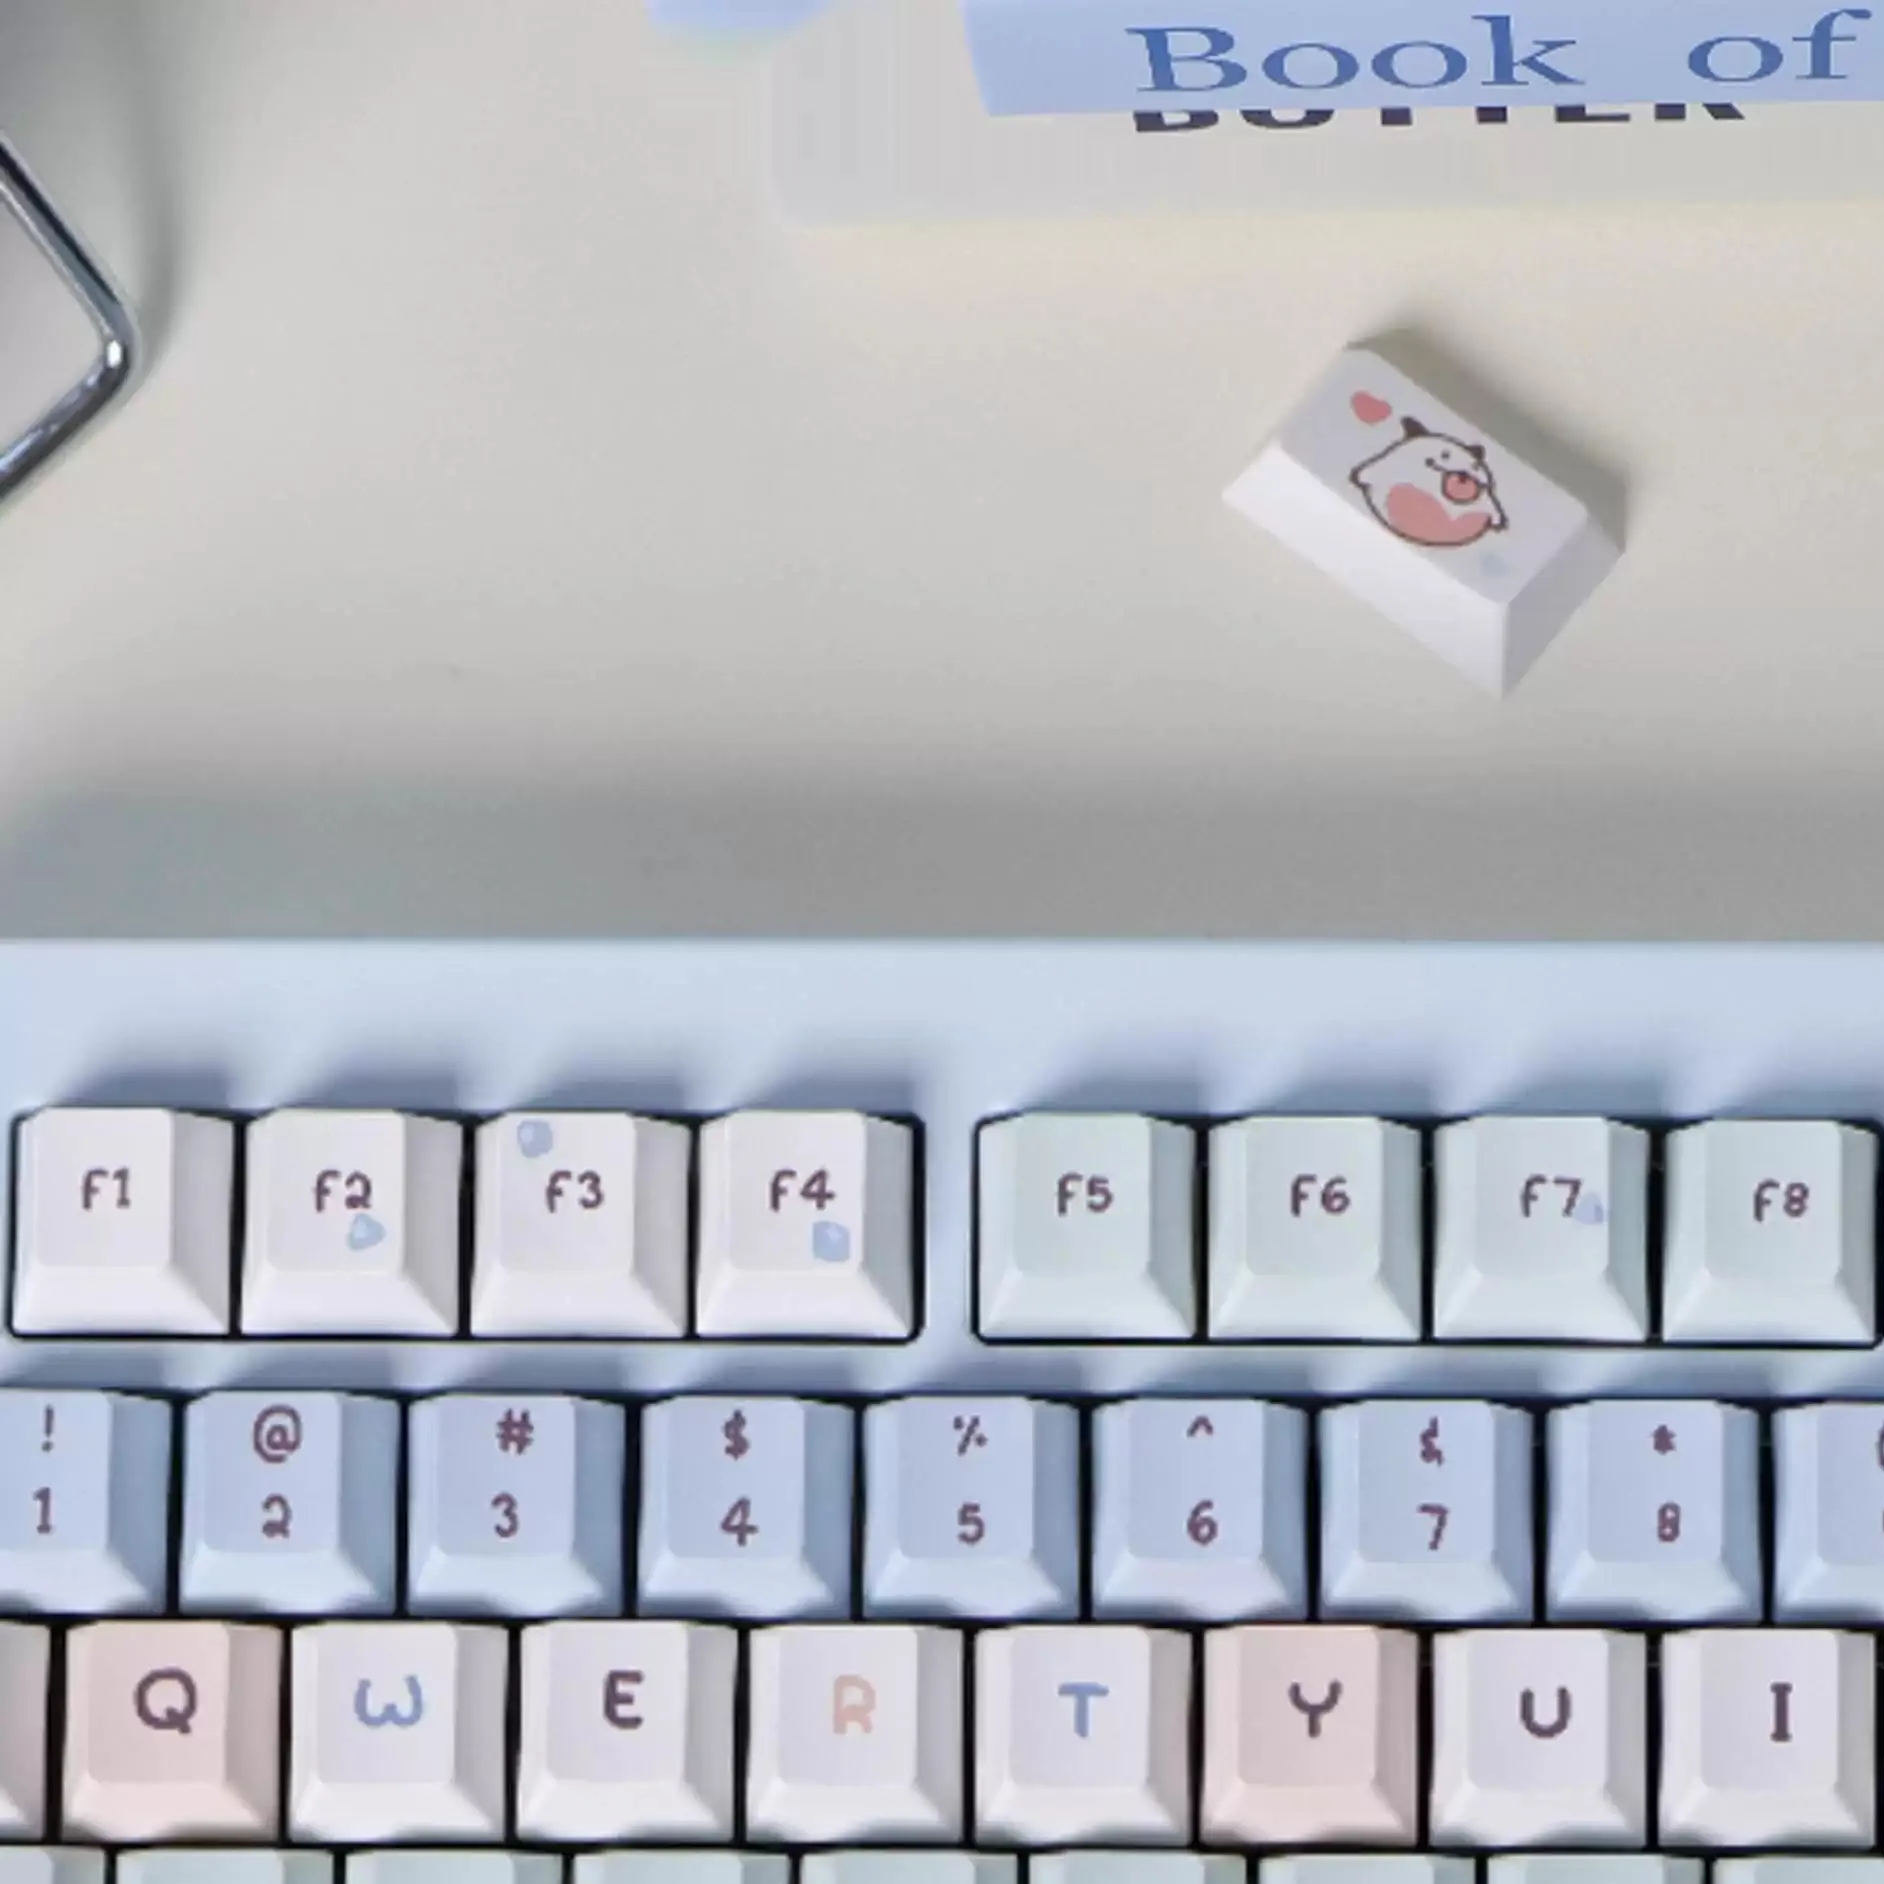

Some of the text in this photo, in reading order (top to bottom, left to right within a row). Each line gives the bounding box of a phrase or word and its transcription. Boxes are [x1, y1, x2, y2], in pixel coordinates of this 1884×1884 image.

[1126, 15, 1584, 91] Book
[1688, 9, 1872, 82] of
[82, 1168, 130, 1210] F1
[315, 1170, 371, 1212] F2
[546, 1170, 604, 1213] F3
[771, 1170, 835, 1212] F4
[1057, 1173, 1112, 1215] F5
[1291, 1175, 1350, 1217] F6
[1521, 1175, 1581, 1217] F7
[1754, 1180, 1809, 1222] F8
[42, 1405, 54, 1452] !
[253, 1405, 301, 1464] @
[497, 1409, 534, 1455] #
[724, 1410, 749, 1460] $
[954, 1416, 987, 1456] %
[1187, 1416, 1213, 1437] ^
[1420, 1417, 1443, 1465] &
[34, 1487, 52, 1534] 1
[262, 1494, 291, 1537] 2
[491, 1493, 518, 1538] 3
[721, 1498, 758, 1546] 4
[958, 1503, 984, 1545] 5
[1187, 1500, 1217, 1546] 6
[1418, 1504, 1448, 1550] 7
[1658, 1503, 1680, 1542] 8
[134, 1668, 197, 1734] Q
[354, 1675, 424, 1728] W
[604, 1670, 643, 1729] E
[832, 1675, 875, 1735] R
[1058, 1683, 1109, 1738] T
[1289, 1681, 1341, 1738] Y
[1520, 1687, 1571, 1738] U
[1771, 1683, 1792, 1742] I
